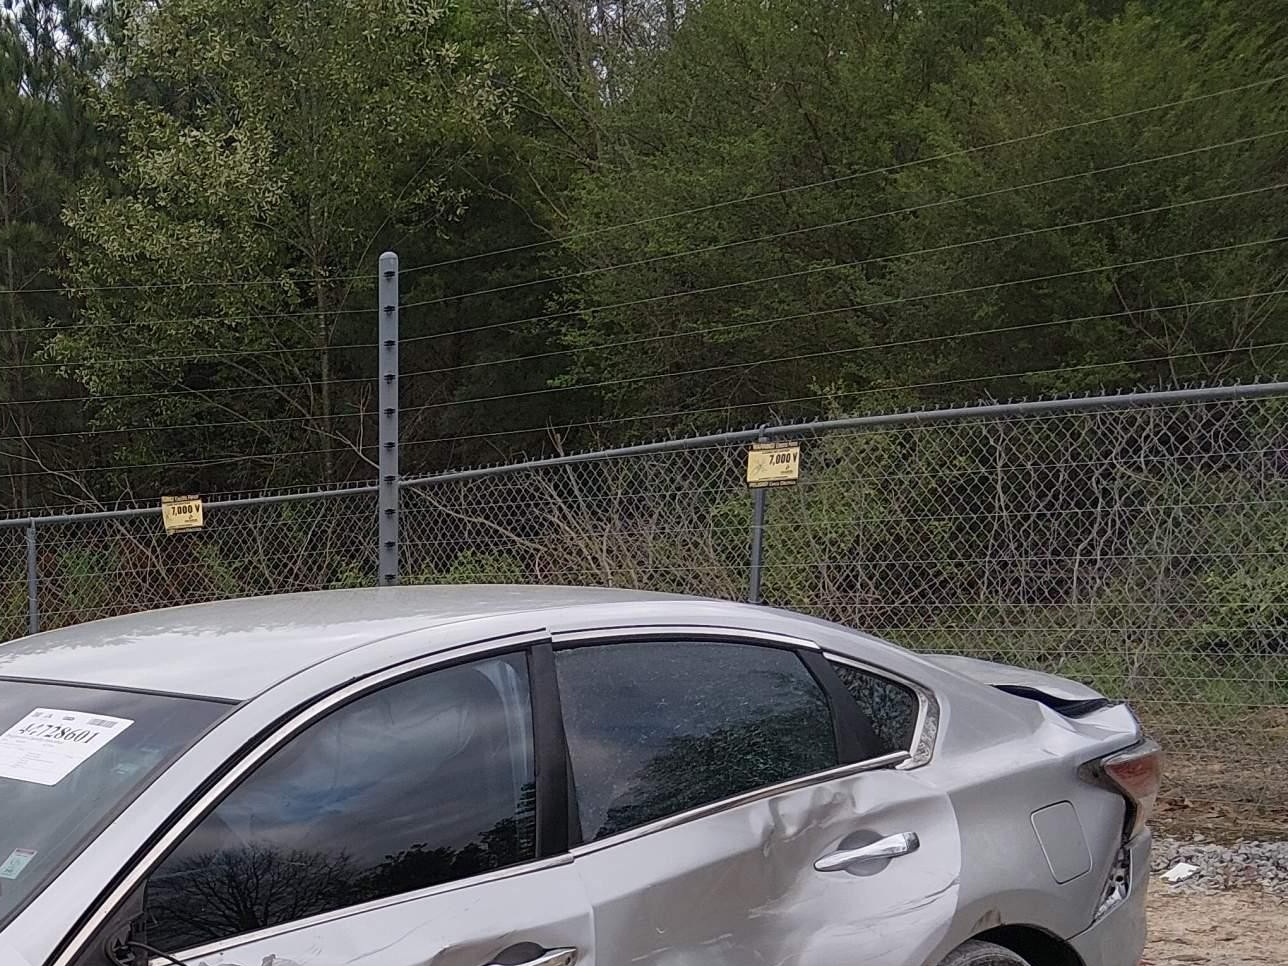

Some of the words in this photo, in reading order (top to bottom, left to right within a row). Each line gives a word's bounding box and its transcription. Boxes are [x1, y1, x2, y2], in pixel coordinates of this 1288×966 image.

[769, 453, 791, 466] 7,000
[793, 452, 798, 463] V
[171, 505, 193, 517] 7,000
[195, 503, 200, 513] V
